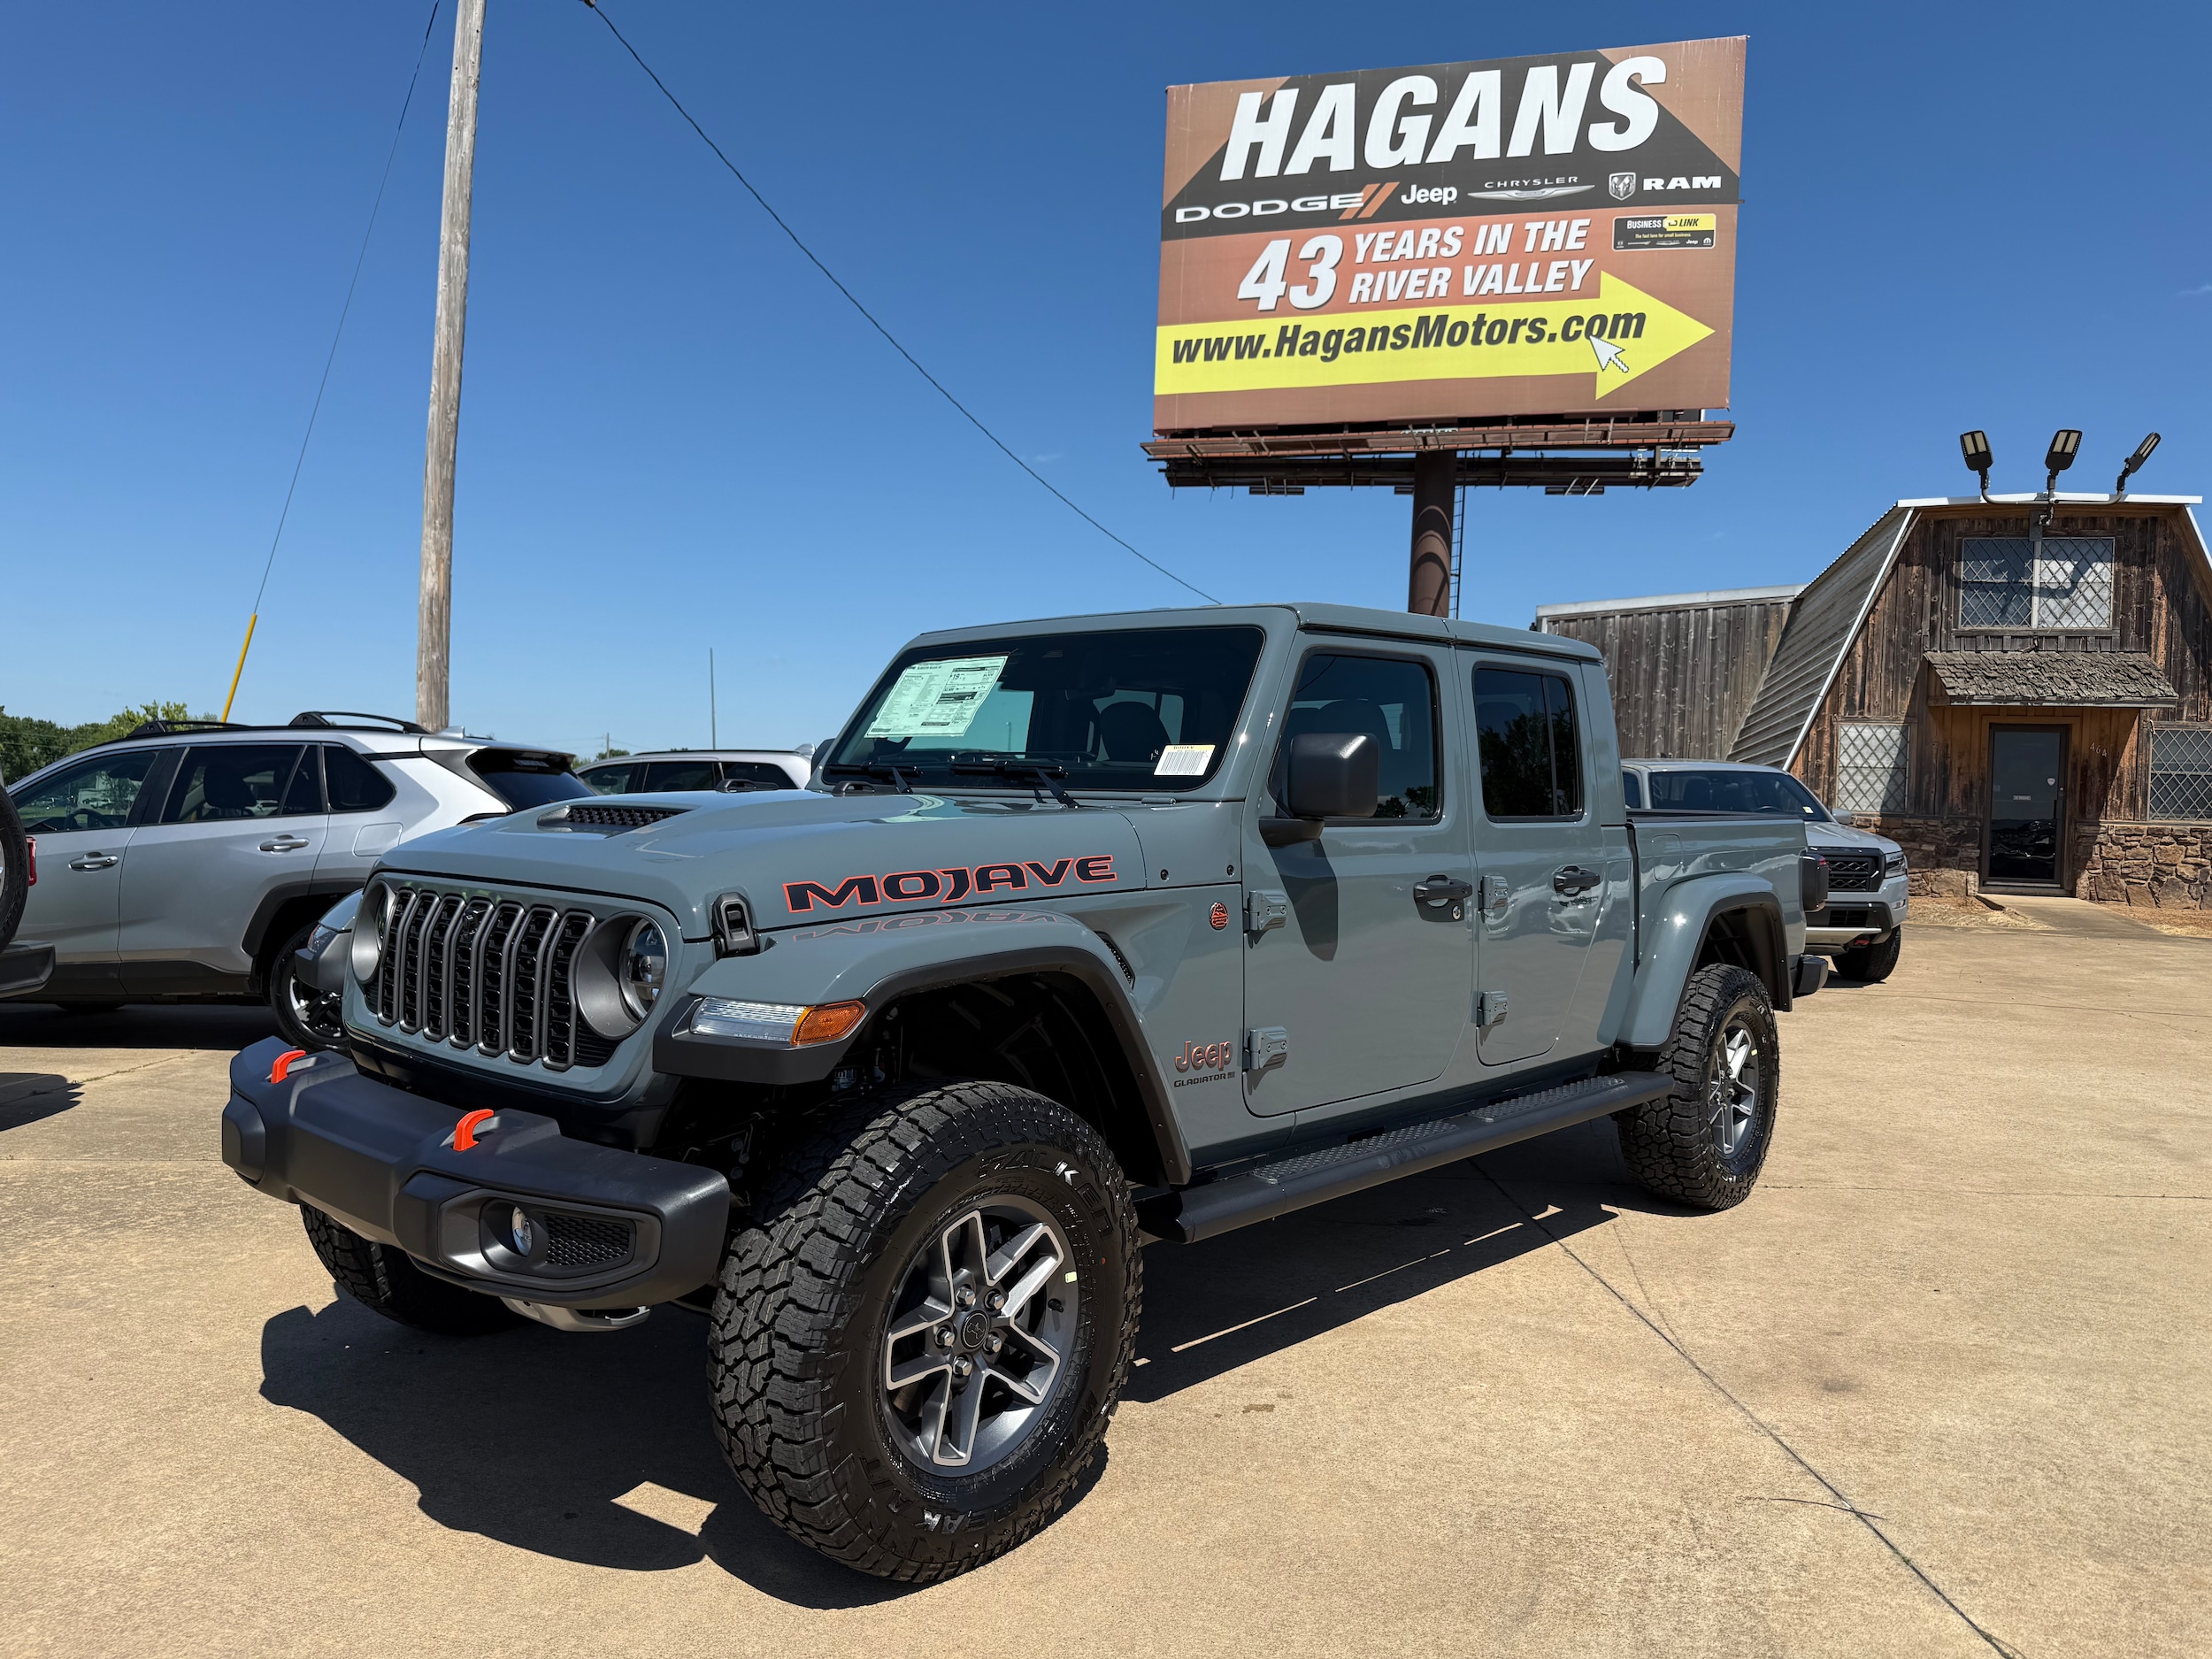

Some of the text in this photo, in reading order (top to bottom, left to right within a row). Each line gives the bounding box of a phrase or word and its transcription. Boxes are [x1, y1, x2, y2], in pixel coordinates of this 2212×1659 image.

[1218, 56, 1667, 181] HAGANS
[1401, 184, 1457, 205] Jeep
[1484, 176, 1578, 188] CHRYSLER
[1643, 176, 1722, 190] RAM
[1175, 192, 1364, 223] DODGE
[1627, 219, 1662, 229] BUSINESS
[1354, 218, 1591, 264] YEARS IN THE
[1237, 234, 1344, 311] 43
[1348, 258, 1594, 303] RIVER VALLEY
[1172, 311, 1646, 363] www.HagansMotors.com
[2090, 742, 2108, 757] 464
[782, 854, 1118, 913] MOJAVE
[1175, 1041, 1233, 1072] Jeep
[1174, 1073, 1226, 1087] GLADIATOR
